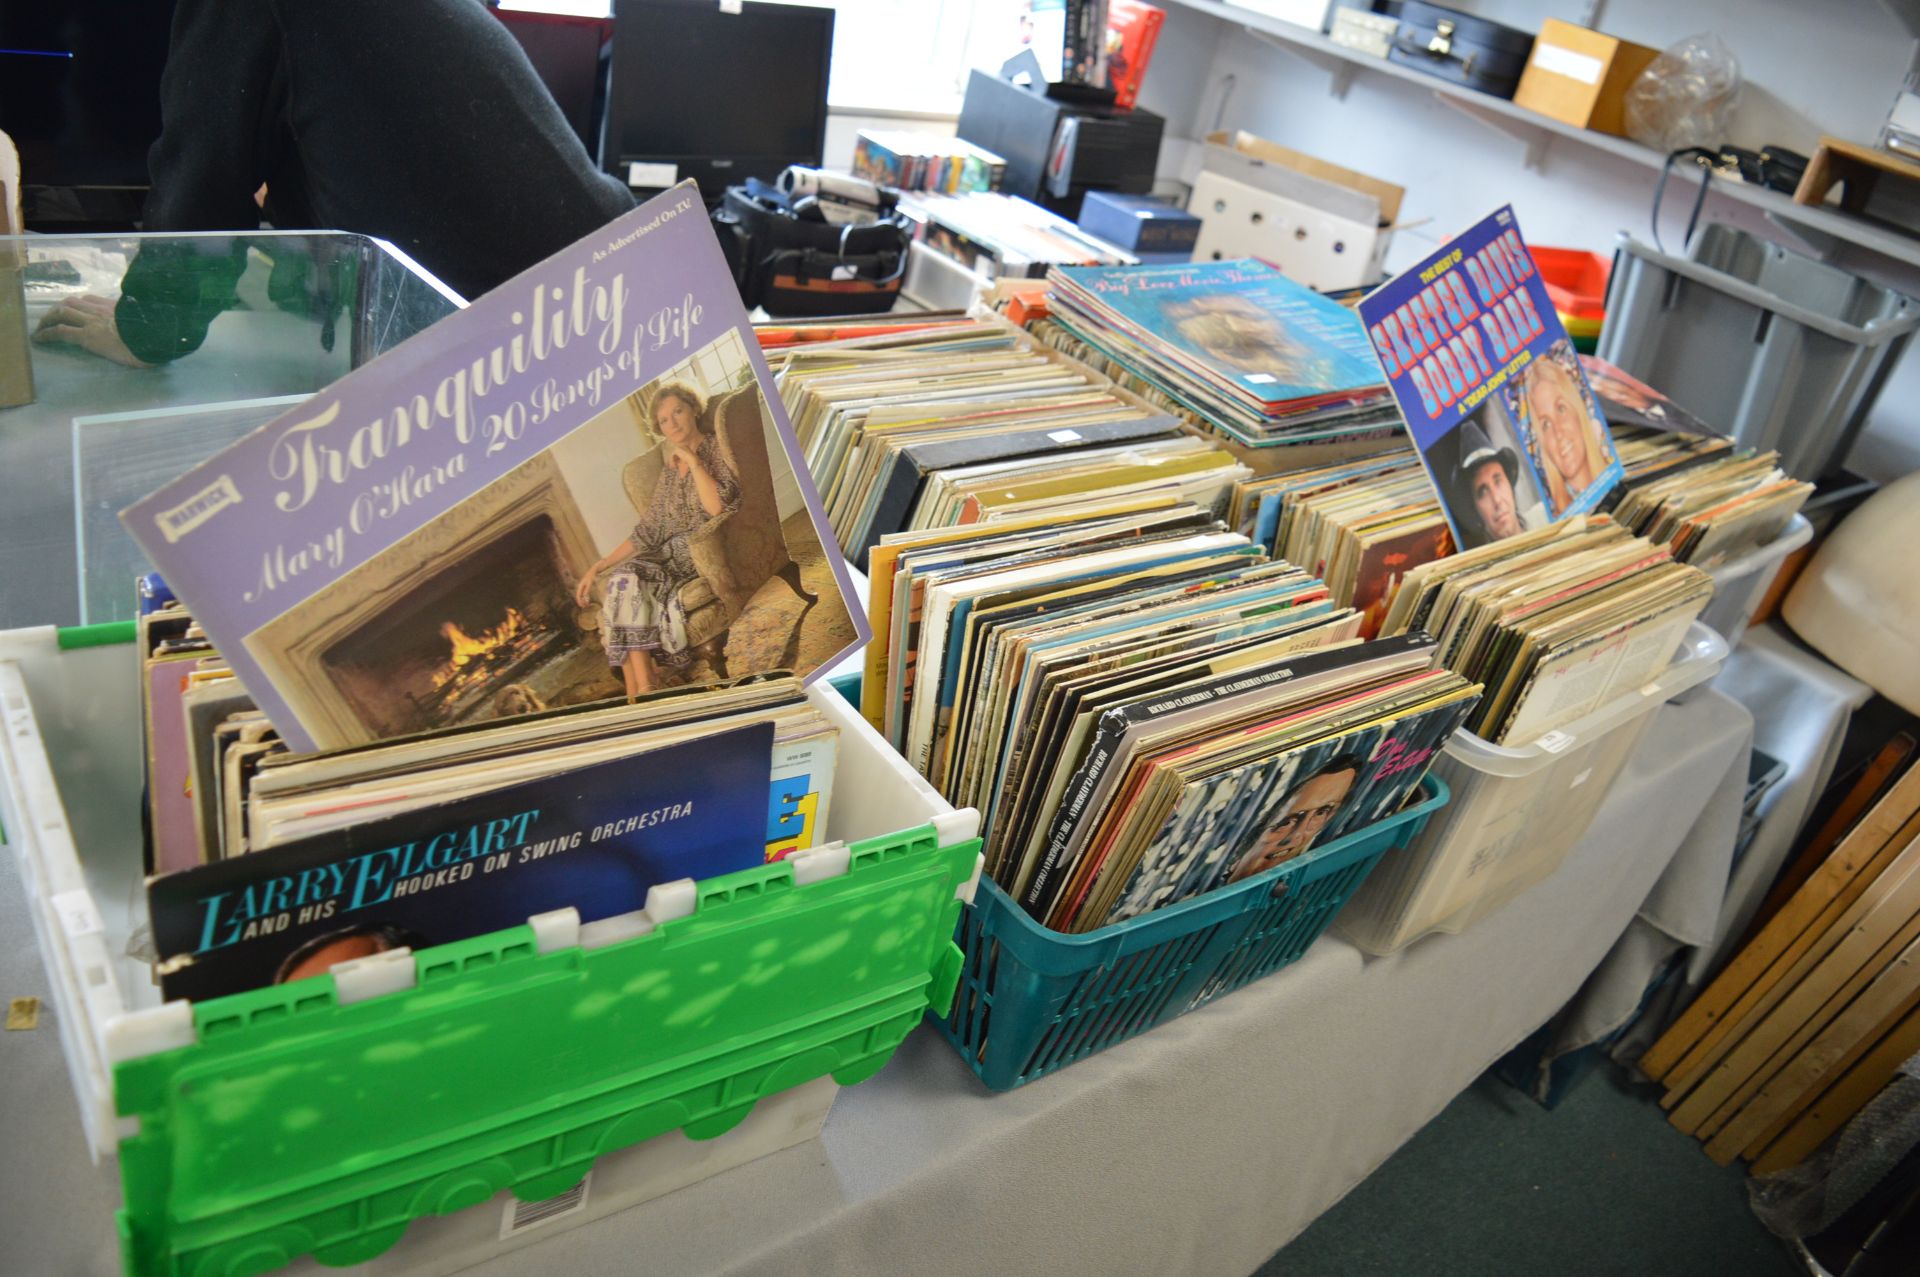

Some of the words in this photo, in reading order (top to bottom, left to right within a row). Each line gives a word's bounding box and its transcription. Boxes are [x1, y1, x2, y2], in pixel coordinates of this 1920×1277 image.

[592, 249, 607, 263] As
[608, 216, 661, 254] Advertised
[661, 210, 677, 222] On
[1371, 270, 1480, 379] SKEETER
[1464, 229, 1534, 307] DAVIS
[269, 266, 629, 512] Tranquility
[483, 401, 526, 457] 20
[531, 378, 615, 425] Songs
[619, 323, 643, 380] of
[648, 293, 704, 351] Life
[1409, 324, 1493, 419] BOBBY
[1480, 286, 1545, 363] BARE
[244, 544, 344, 602] Mary
[351, 453, 468, 535] O'Hara
[1088, 748, 1108, 780] RICHARD
[1147, 700, 1177, 715] RICHARD
[190, 857, 357, 957] LARRY
[342, 809, 541, 914] ELGART
[243, 913, 291, 941] AND
[298, 900, 337, 926] HIS
[394, 862, 475, 899] HOOKED
[483, 852, 511, 874] ON
[518, 832, 583, 865] SWING
[590, 800, 694, 843] ORCHESTRA
